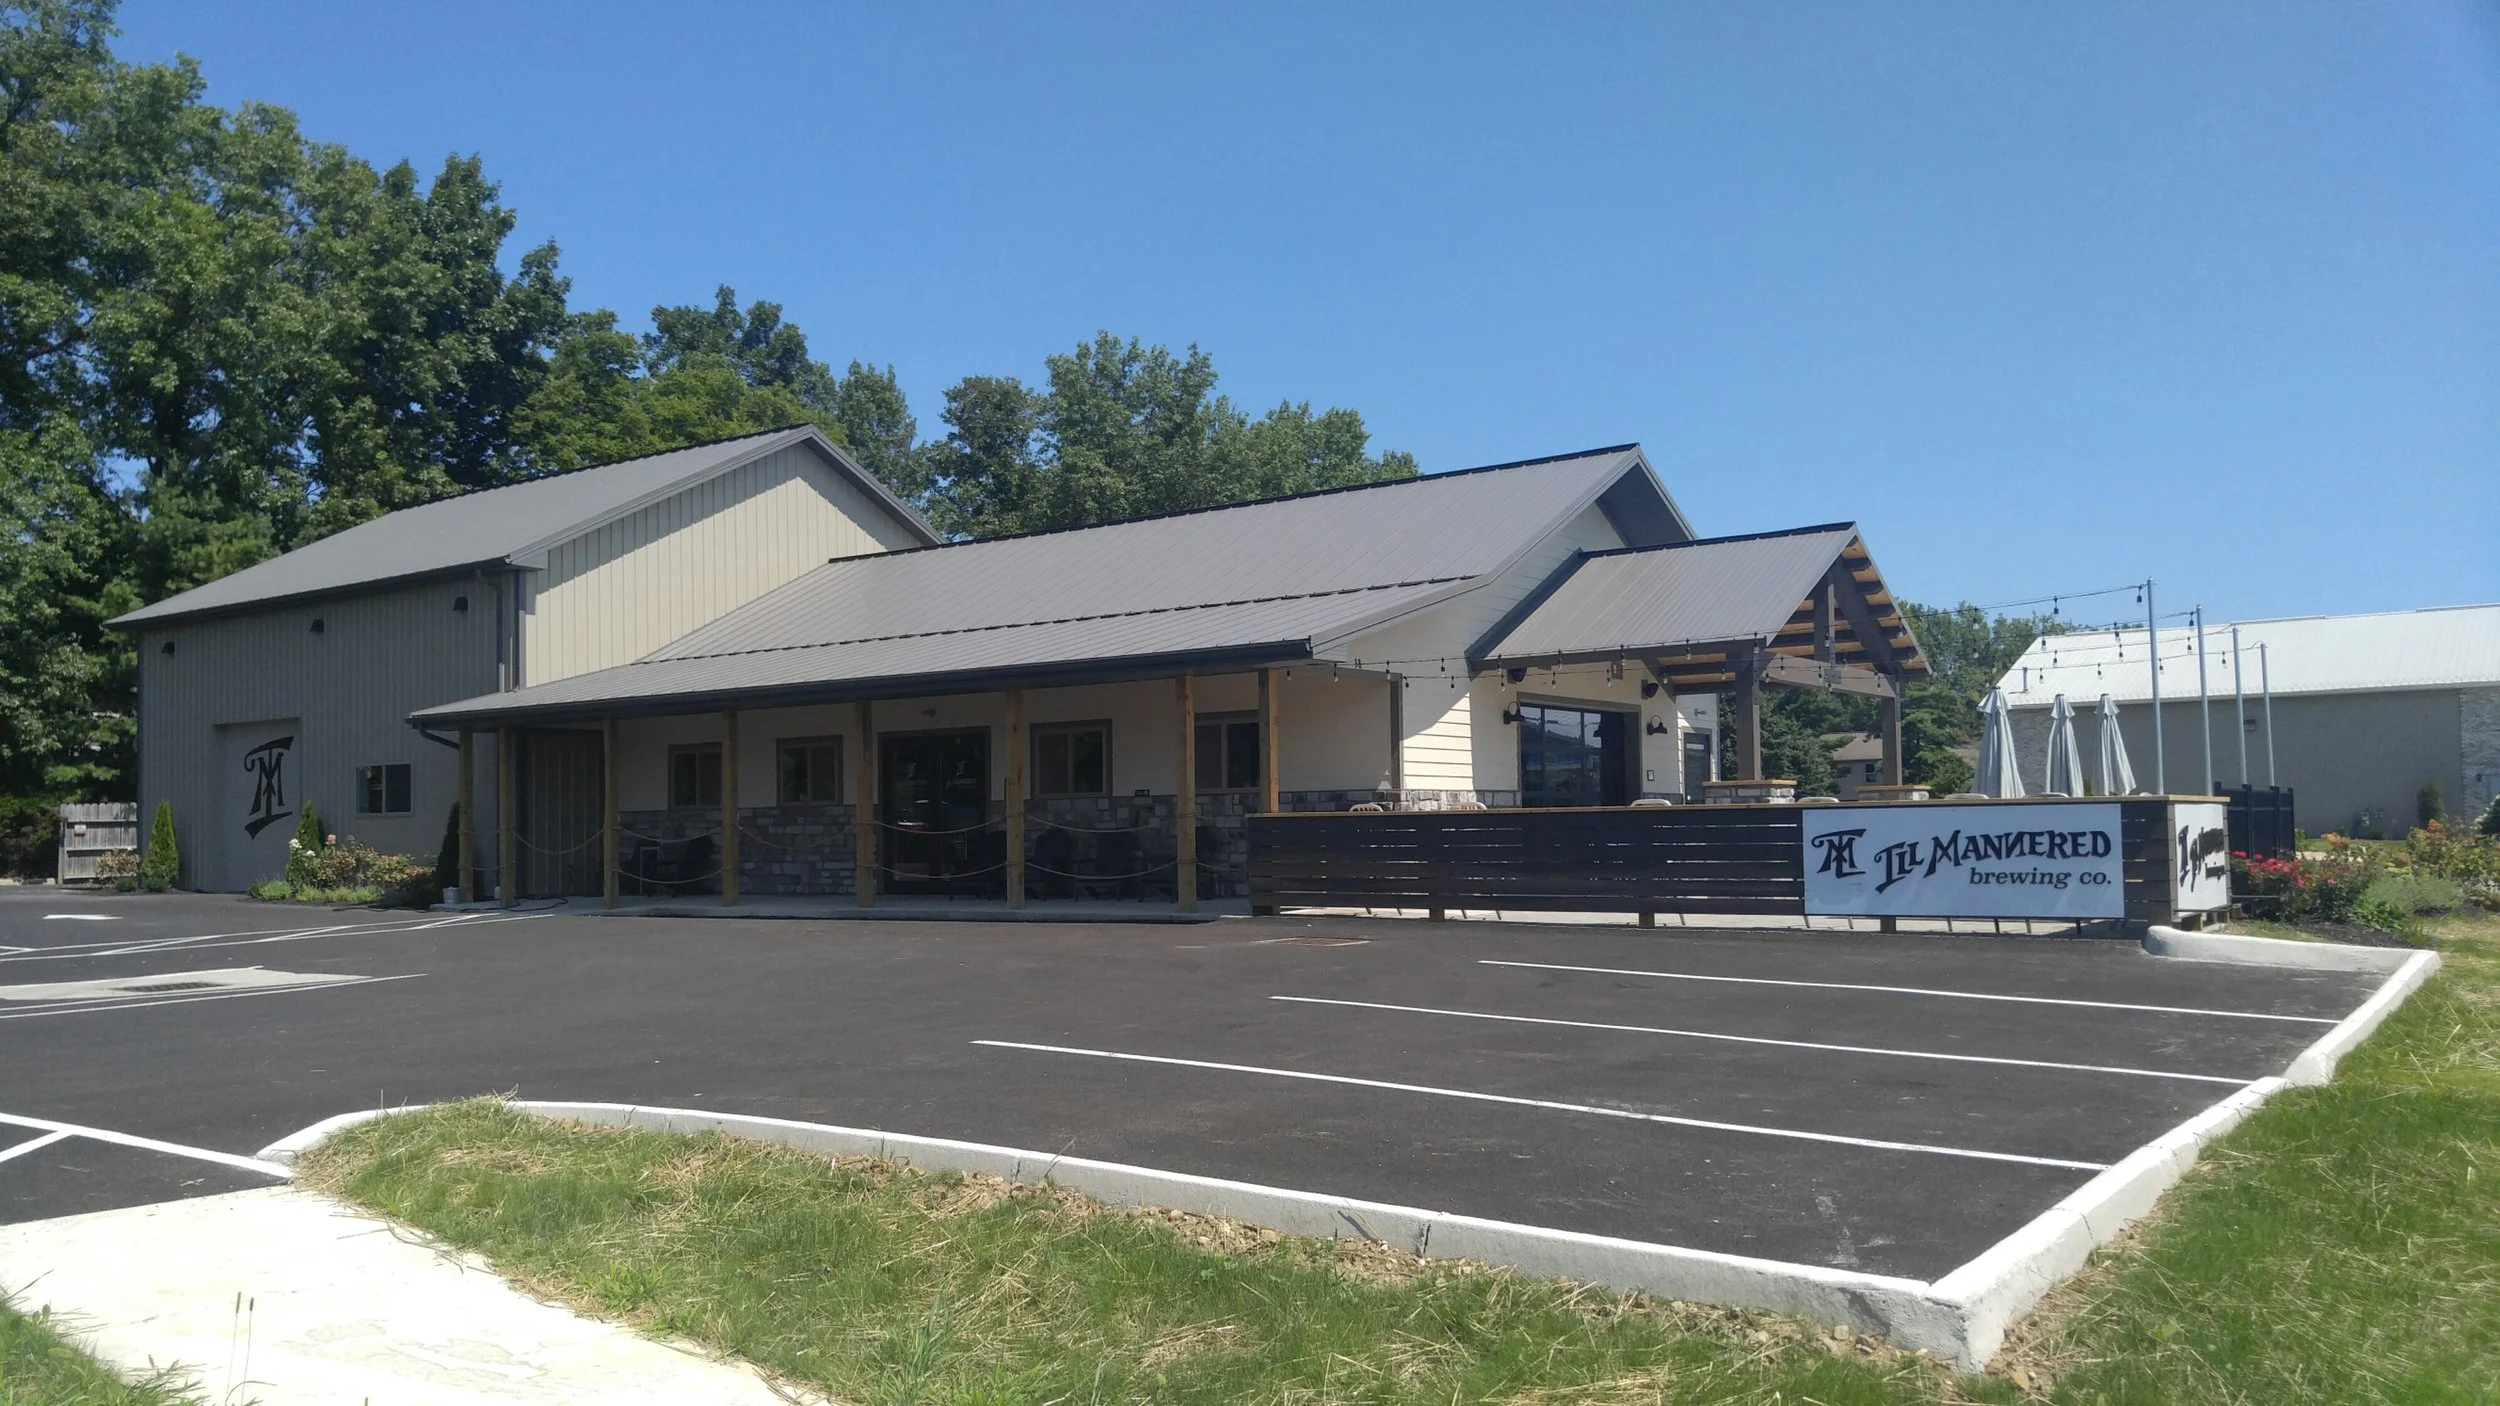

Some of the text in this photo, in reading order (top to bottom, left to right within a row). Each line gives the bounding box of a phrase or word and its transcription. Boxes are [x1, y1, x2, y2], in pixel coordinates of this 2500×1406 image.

[1922, 829, 2112, 879] MANNERED
[1969, 866, 2112, 890] brewing co.
